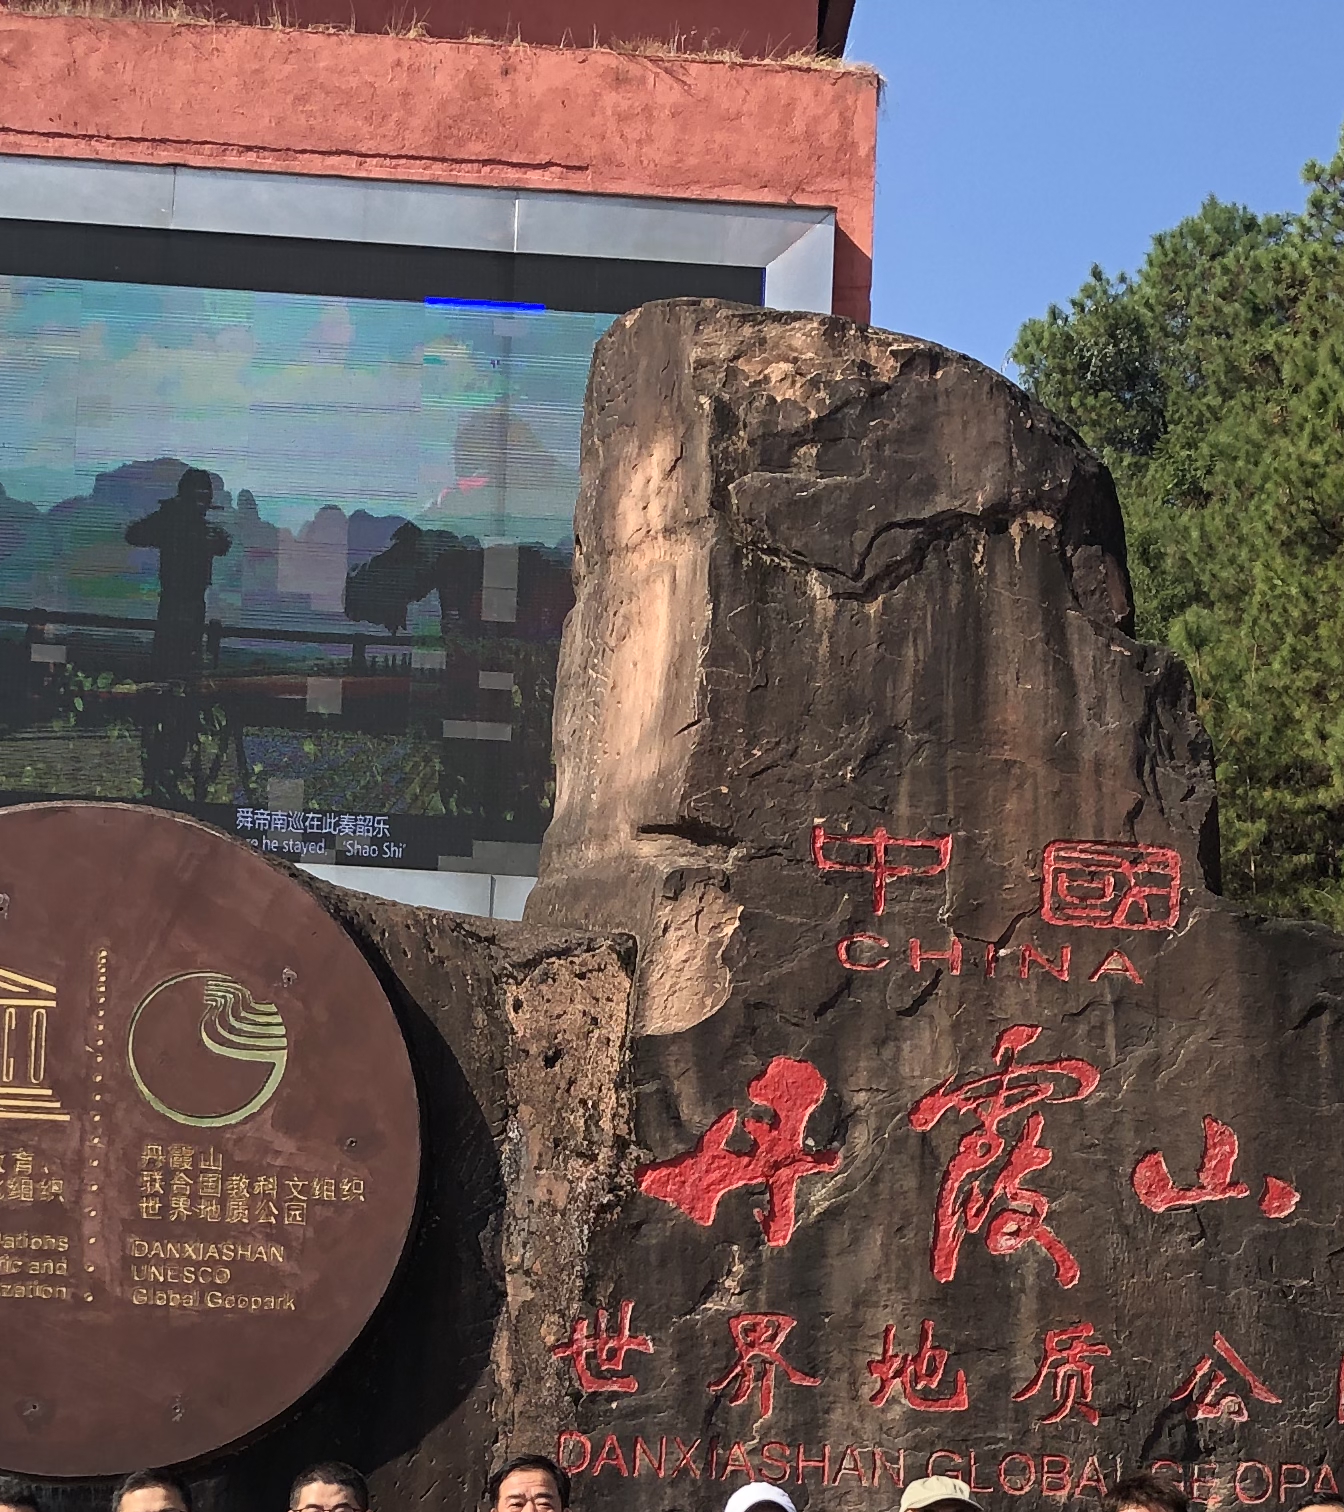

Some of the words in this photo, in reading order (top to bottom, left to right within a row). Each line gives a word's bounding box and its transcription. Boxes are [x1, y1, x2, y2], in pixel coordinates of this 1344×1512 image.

[236, 808, 390, 838] 舜帝南巡在此奏韶乐
[262, 835, 279, 851] he
[836, 933, 1144, 985] CHINA
[140, 1144, 223, 1171] 丹霞山
[636, 1024, 1301, 1289] 丹霞山
[140, 1171, 365, 1202] 联合国教科文组织
[138, 1196, 307, 1226] 世界地质公园
[131, 1239, 285, 1263] DANXIASHAN
[28, 1257, 68, 1276] and
[131, 1264, 232, 1285] UNESCO
[131, 1287, 200, 1308] Global
[206, 1290, 296, 1313] Geopark
[557, 1429, 906, 1488] DANXIASHAN
